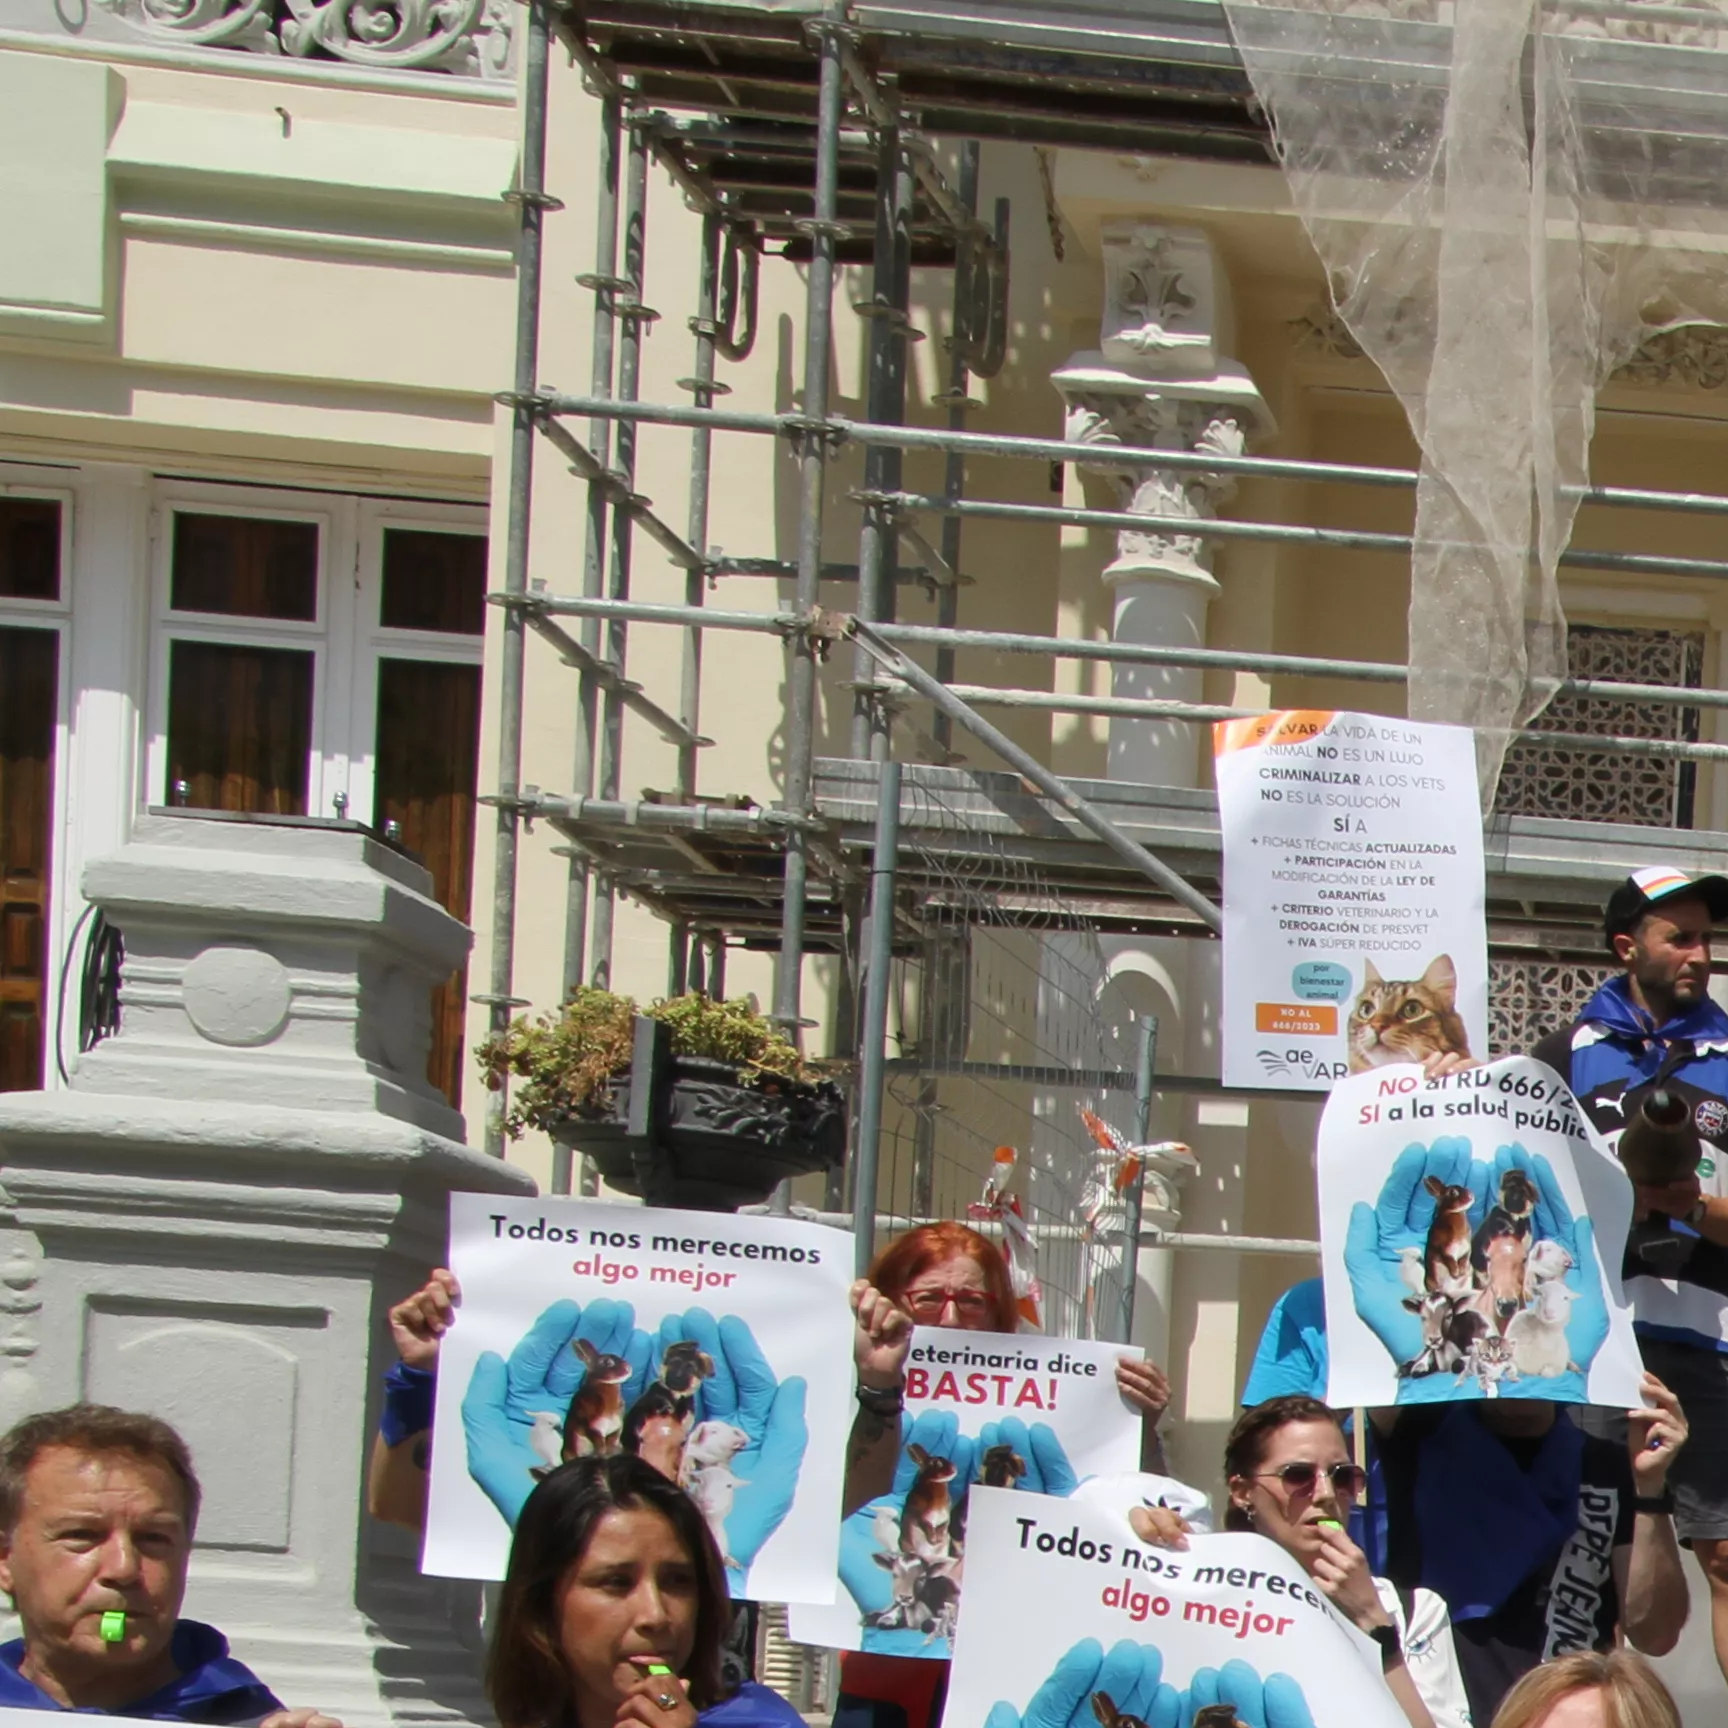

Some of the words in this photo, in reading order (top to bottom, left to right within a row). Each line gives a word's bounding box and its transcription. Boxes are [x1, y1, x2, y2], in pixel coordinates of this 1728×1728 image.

[1257, 723, 1319, 738] SLVAR
[1344, 726, 1380, 740] VIDA
[1381, 728, 1399, 741] DE
[1403, 732, 1422, 745] UN
[1317, 746, 1338, 759] NO
[1343, 748, 1361, 762] ES
[1365, 750, 1385, 763] UN
[1390, 752, 1424, 766] LUJO
[1259, 767, 1361, 786] CRIMINALIZAR
[1379, 774, 1408, 788] LOS
[1411, 777, 1446, 791] VETS
[1260, 789, 1283, 801] NO
[1326, 793, 1401, 809] SOLUCIÓN
[1334, 813, 1350, 832] SÍ
[1355, 819, 1368, 833] A
[1262, 835, 1302, 849] FICHAS
[1305, 837, 1363, 852] TÉCNICAS
[1365, 842, 1457, 855] ACTUALIZADAS
[1294, 855, 1386, 870] PARTICIPACIÓN
[1271, 870, 1359, 885] MODIFICACIÓN
[1397, 875, 1416, 886] LEY
[1420, 876, 1436, 886] DE
[1318, 888, 1386, 902] GARANTÍAS
[1282, 903, 1334, 916] CRITERIO
[1336, 906, 1412, 919] VETERINARIO
[1279, 919, 1360, 934] DEROGACIÓN
[1381, 924, 1429, 935] PRESVET
[1298, 938, 1317, 948] IVA
[1319, 937, 1356, 950] SÚPER
[1359, 940, 1422, 951] REDUCIDO
[1377, 1076, 1418, 1098] NO
[1498, 1072, 1578, 1111] 666/2
[1359, 1104, 1380, 1125] SI
[1388, 1106, 1404, 1121] a
[1412, 1098, 1434, 1120] la
[1444, 1094, 1509, 1120] salud
[1515, 1108, 1588, 1141] públic
[489, 1213, 580, 1248] Todos
[588, 1231, 641, 1250] nos
[651, 1232, 822, 1266] merecemos
[572, 1253, 640, 1285] algo
[650, 1258, 738, 1293] mejor
[910, 1345, 1039, 1372] eterinaria
[1047, 1353, 1099, 1377] dice
[906, 1367, 1059, 1411] BASTA!
[1015, 1517, 1113, 1564] Todos
[1121, 1549, 1180, 1580] nos
[1101, 1578, 1170, 1622] algo
[1182, 1597, 1295, 1639] mejor
